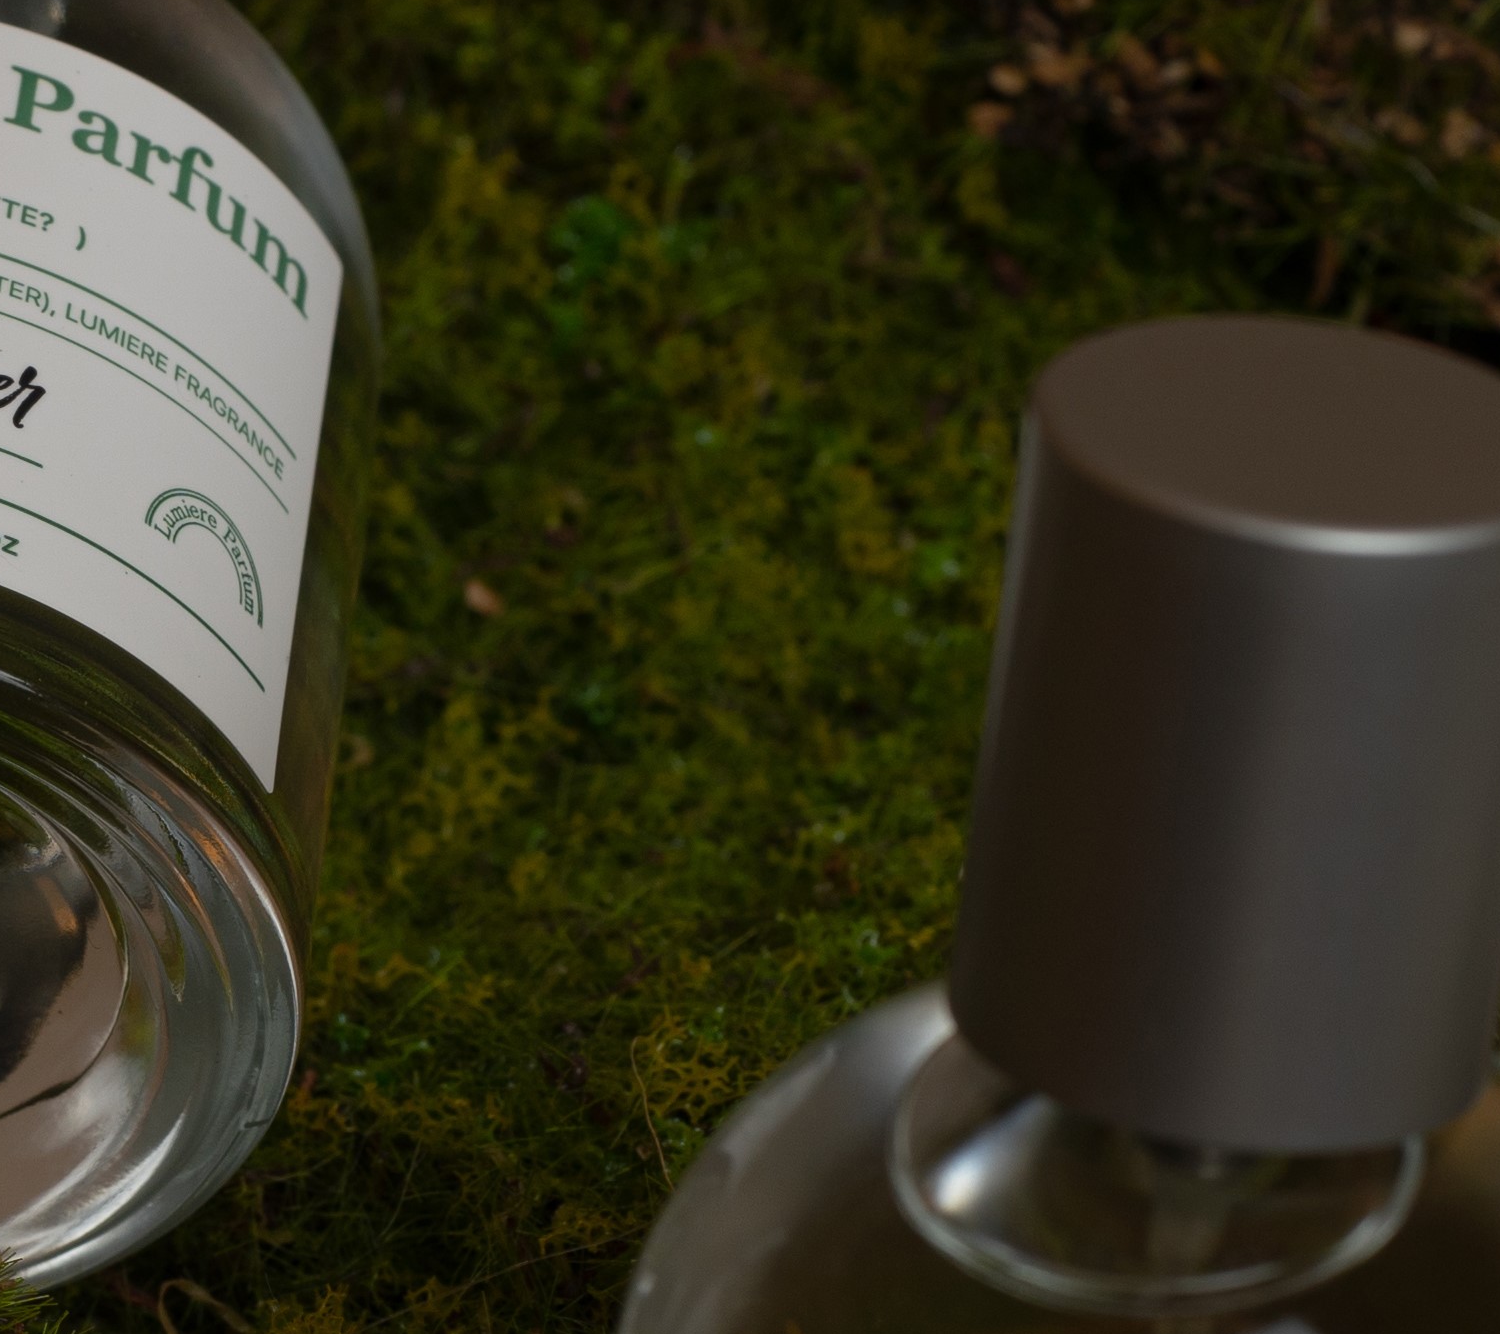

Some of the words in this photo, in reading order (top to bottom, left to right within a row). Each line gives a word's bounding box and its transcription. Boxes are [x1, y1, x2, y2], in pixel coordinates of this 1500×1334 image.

[3, 64, 309, 321] Parfum
[64, 301, 169, 375] LUMIERE
[173, 363, 286, 482] FRAGRANCE
[154, 499, 218, 541] Lumiere
[222, 527, 255, 616] Parfum
